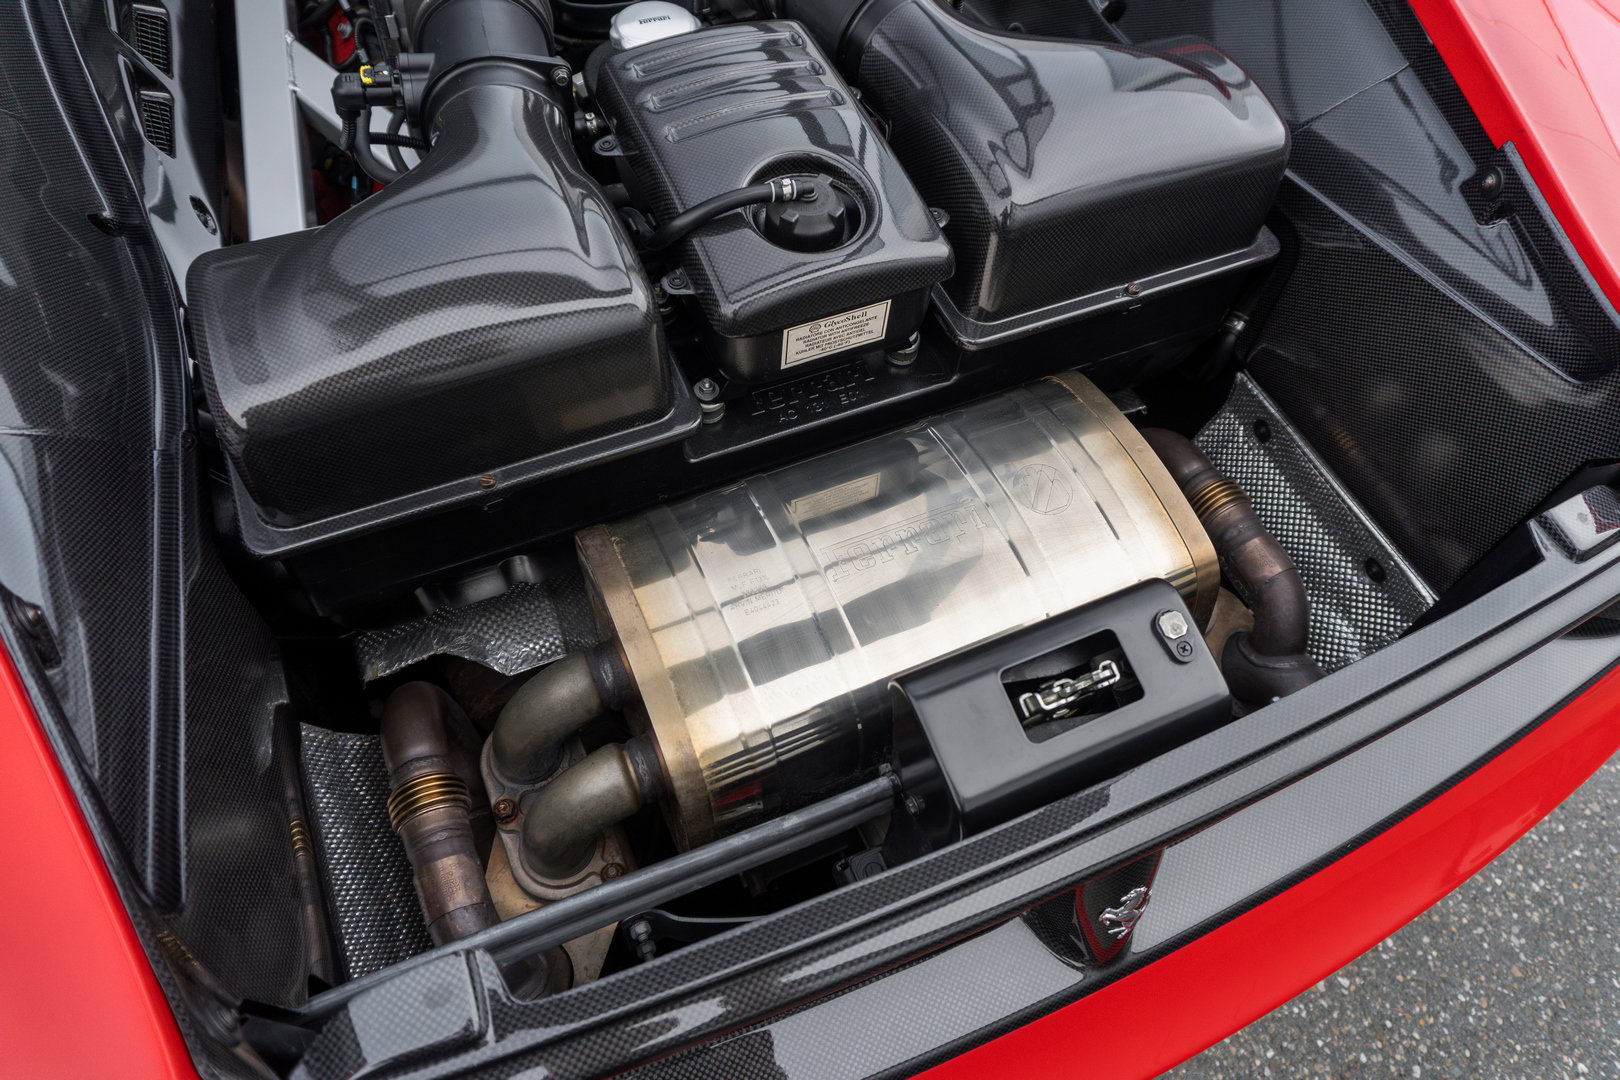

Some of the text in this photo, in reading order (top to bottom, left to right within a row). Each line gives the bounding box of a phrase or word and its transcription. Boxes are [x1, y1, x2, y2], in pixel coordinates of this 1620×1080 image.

[639, 15, 671, 24] Ferrari
[824, 311, 867, 328] GlycoShell
[796, 331, 823, 342] RADIATORE
[803, 334, 827, 344] RADIATOR
